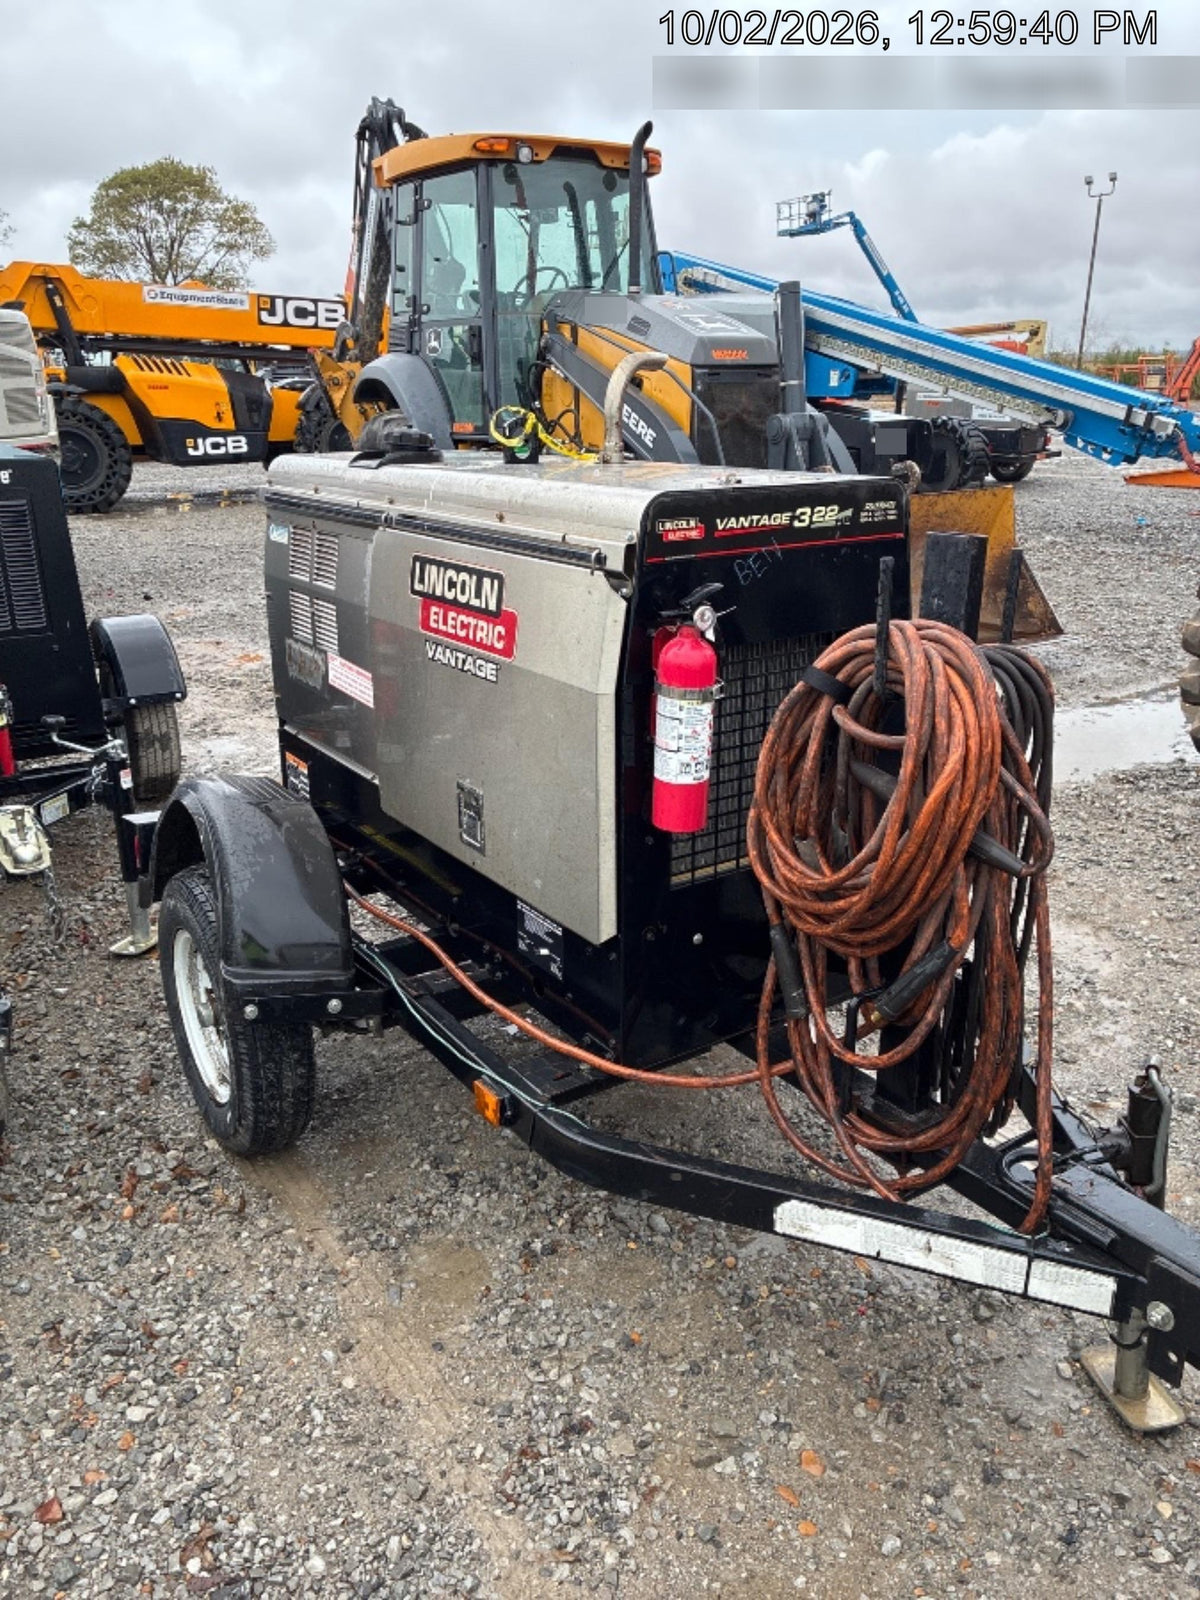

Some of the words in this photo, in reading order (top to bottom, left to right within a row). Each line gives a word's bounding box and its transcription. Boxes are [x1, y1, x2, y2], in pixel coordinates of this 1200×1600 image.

[260, 298, 346, 328] JCB
[622, 403, 657, 449] EERE
[187, 435, 249, 456] JCB
[658, 519, 697, 531] LINCOLN
[716, 512, 793, 531] VANTAGE
[793, 504, 840, 527] 322
[413, 561, 499, 612] LINCOLN
[429, 605, 505, 650] ELECTRIC
[425, 640, 499, 682] VANTAGE
